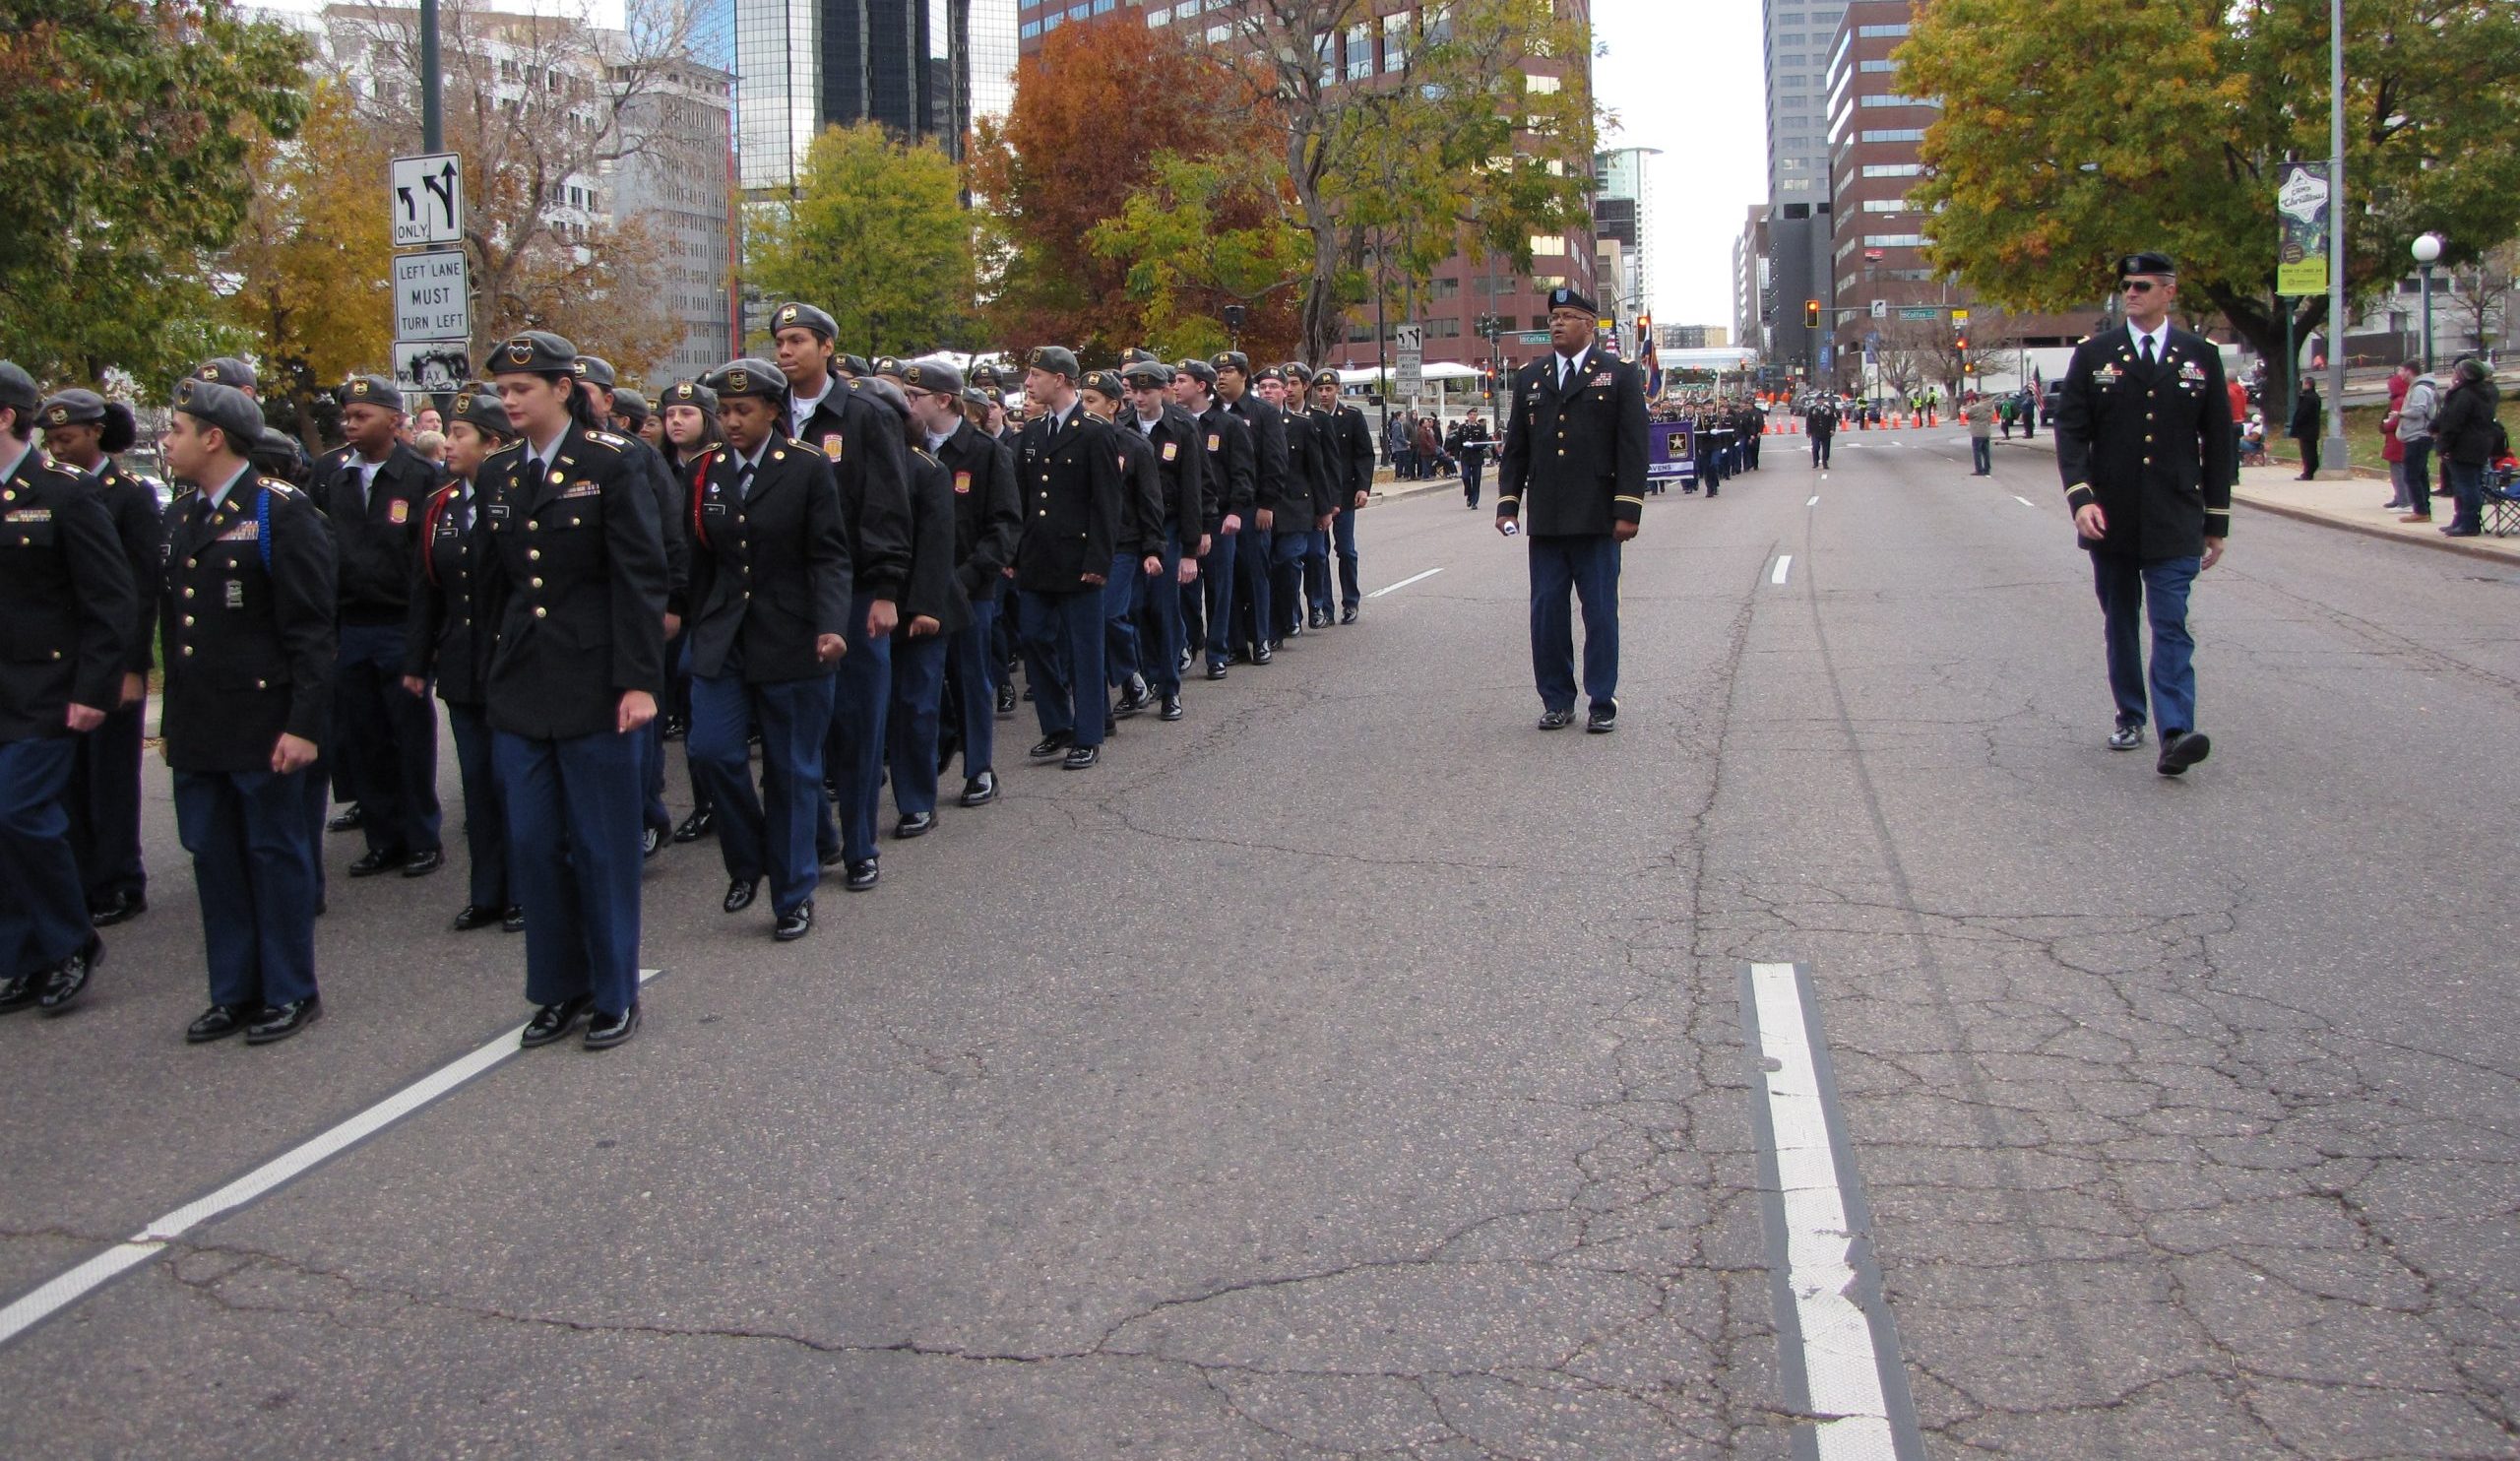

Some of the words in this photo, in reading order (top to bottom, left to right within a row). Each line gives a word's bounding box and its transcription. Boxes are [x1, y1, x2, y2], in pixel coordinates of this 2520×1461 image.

[398, 224, 428, 239] ONLY
[400, 265, 425, 280] LEFT
[431, 262, 460, 278] LANE
[411, 287, 450, 306] MUST
[402, 315, 429, 331] TURN
[436, 313, 464, 329] LEFT
